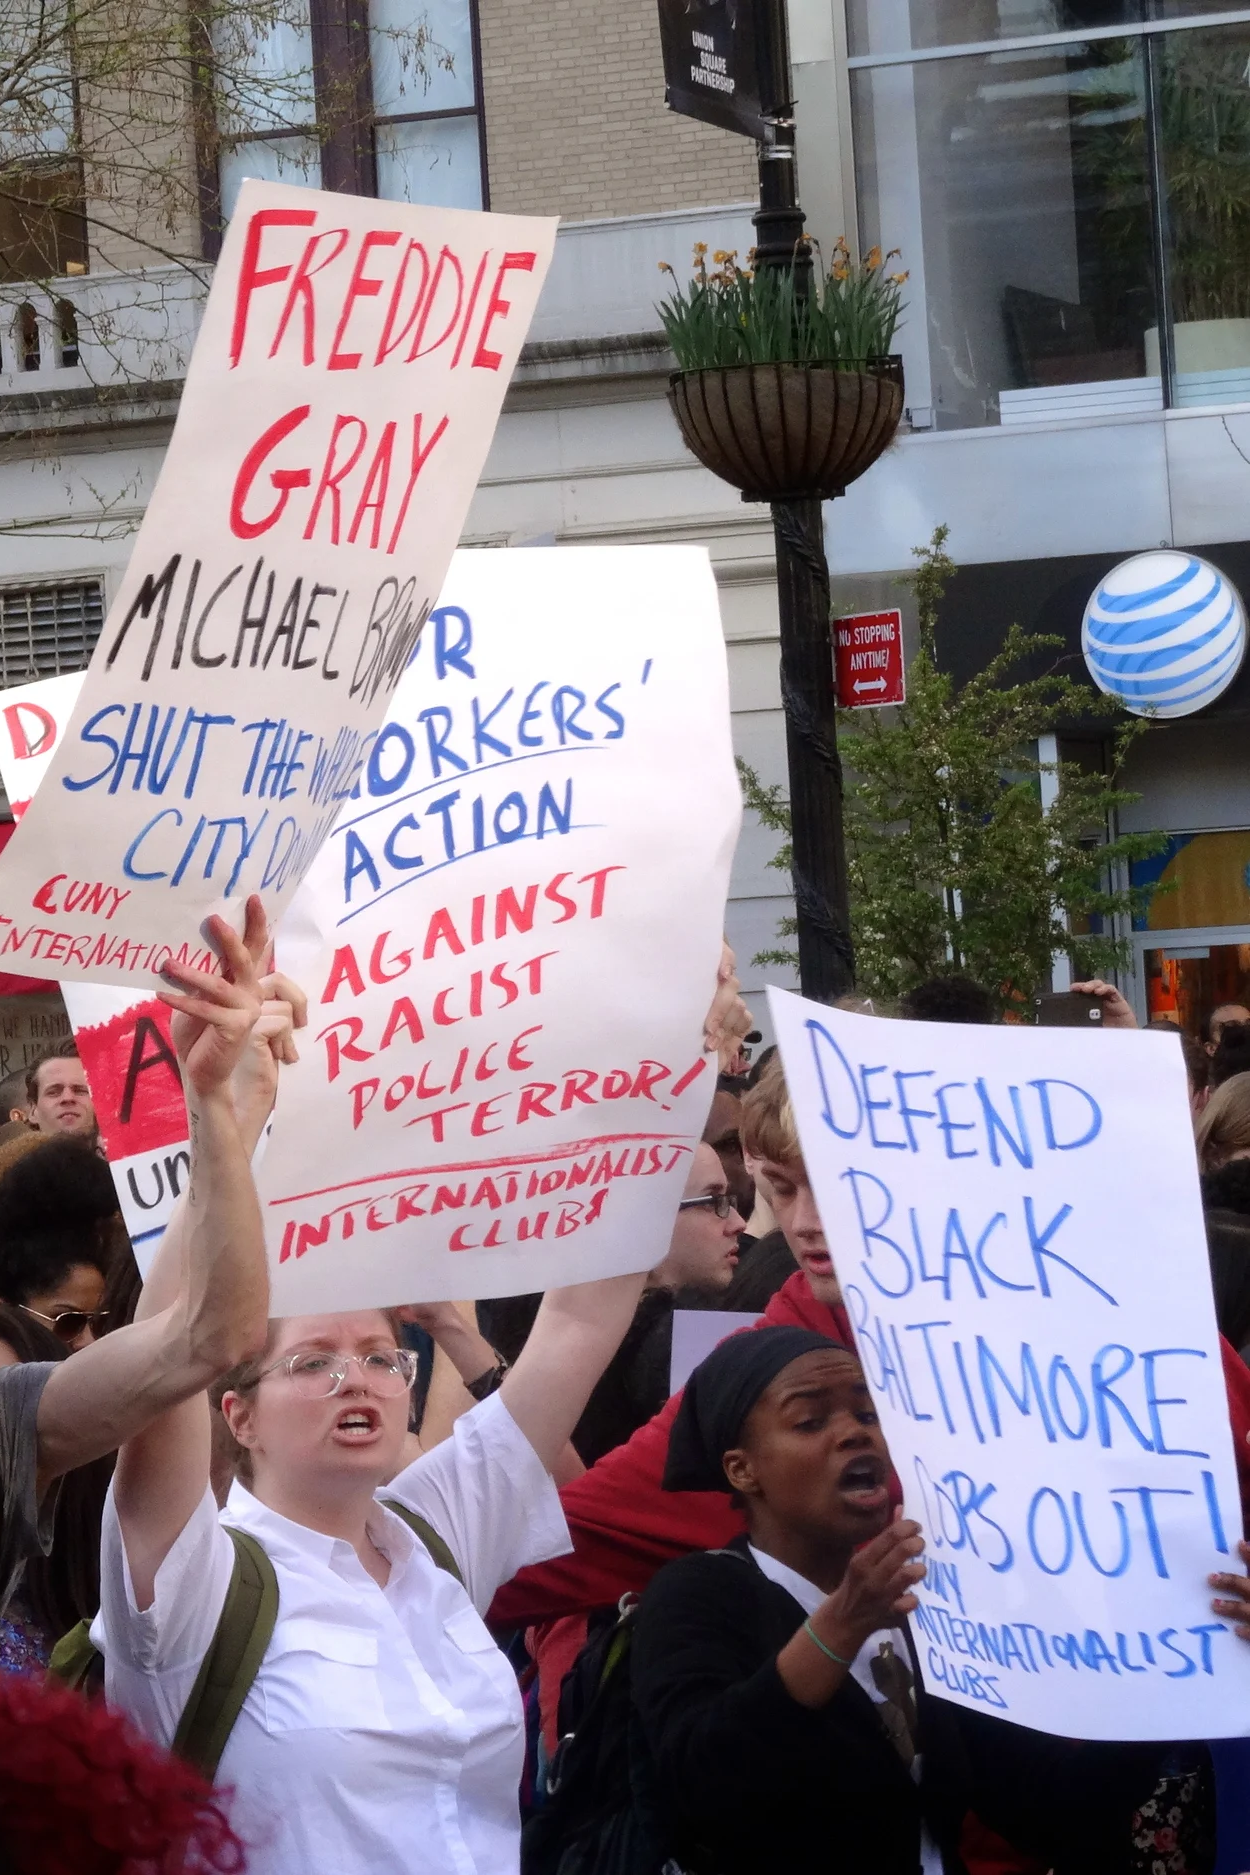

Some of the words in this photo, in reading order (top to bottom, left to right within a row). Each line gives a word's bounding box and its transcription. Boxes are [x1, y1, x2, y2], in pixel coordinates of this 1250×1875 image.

[690, 65, 735, 94] PARTNERSHIP
[691, 30, 715, 52] UNION
[700, 51, 727, 74] SQUARE
[229, 208, 537, 371] FREDDIE
[229, 404, 450, 554] GRAY
[105, 553, 350, 682] MICHAEL
[838, 629, 851, 648] NO
[853, 623, 896, 645] STOPPING
[62, 702, 236, 800] SHUT
[241, 717, 313, 802] THE
[32, 873, 132, 920] CUNY
[122, 807, 270, 900] CITY
[344, 777, 574, 904] ACTION
[320, 865, 628, 1004] AGAINST
[314, 950, 559, 1084] RACIST
[347, 1025, 544, 1131] POLICE
[403, 1057, 706, 1143] TERROR!
[804, 1018, 1103, 1169] DEFEND
[278, 1144, 693, 1264] INTERNATIONALIST
[448, 1188, 609, 1252] CLUBS
[839, 1166, 1119, 1306] BLACK
[845, 1283, 1210, 1459] BALTIMORE
[914, 1454, 1015, 1574] COPS
[928, 1646, 1009, 1709] CLUBS
